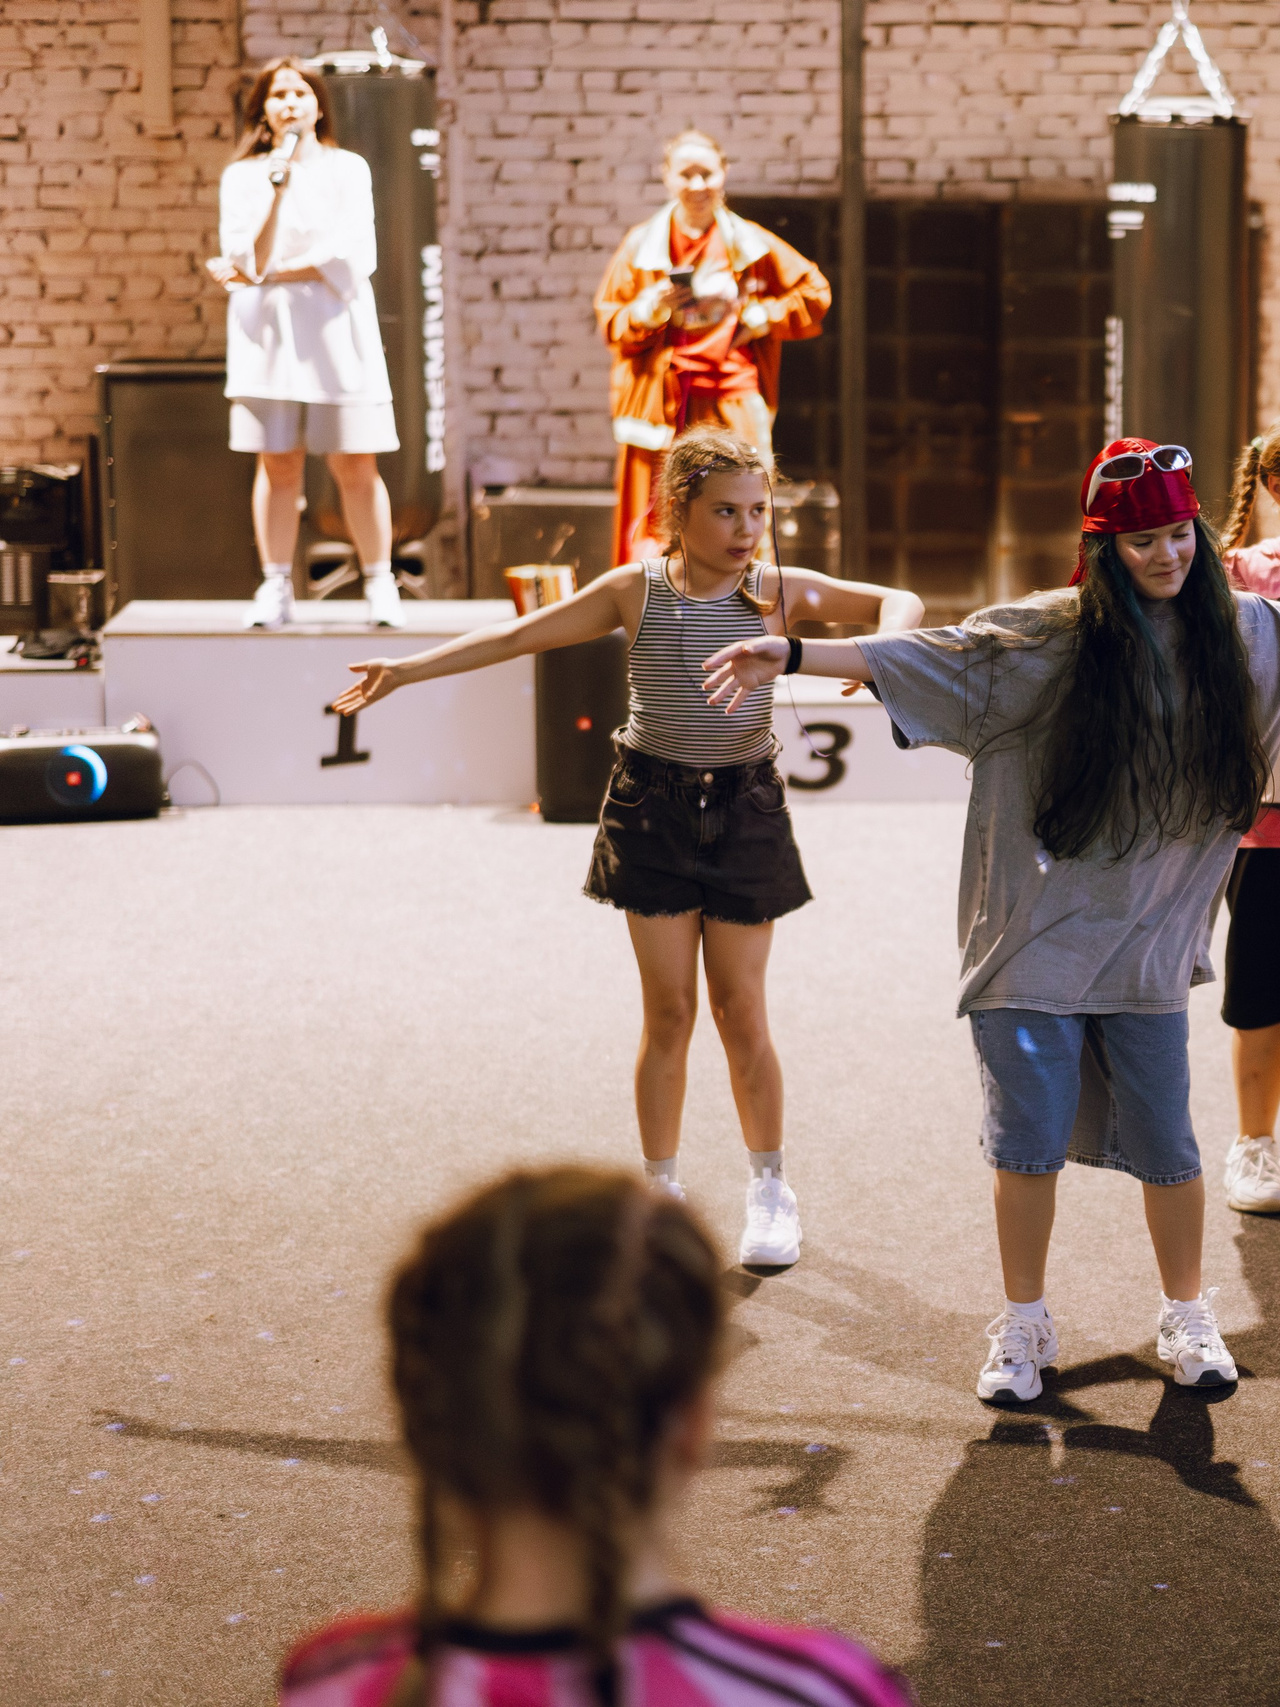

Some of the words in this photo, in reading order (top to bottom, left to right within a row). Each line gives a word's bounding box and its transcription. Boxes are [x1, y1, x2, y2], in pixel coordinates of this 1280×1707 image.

[420, 244, 446, 473] PREMIUM
[320, 704, 371, 768] 1
[787, 721, 856, 792] 3
